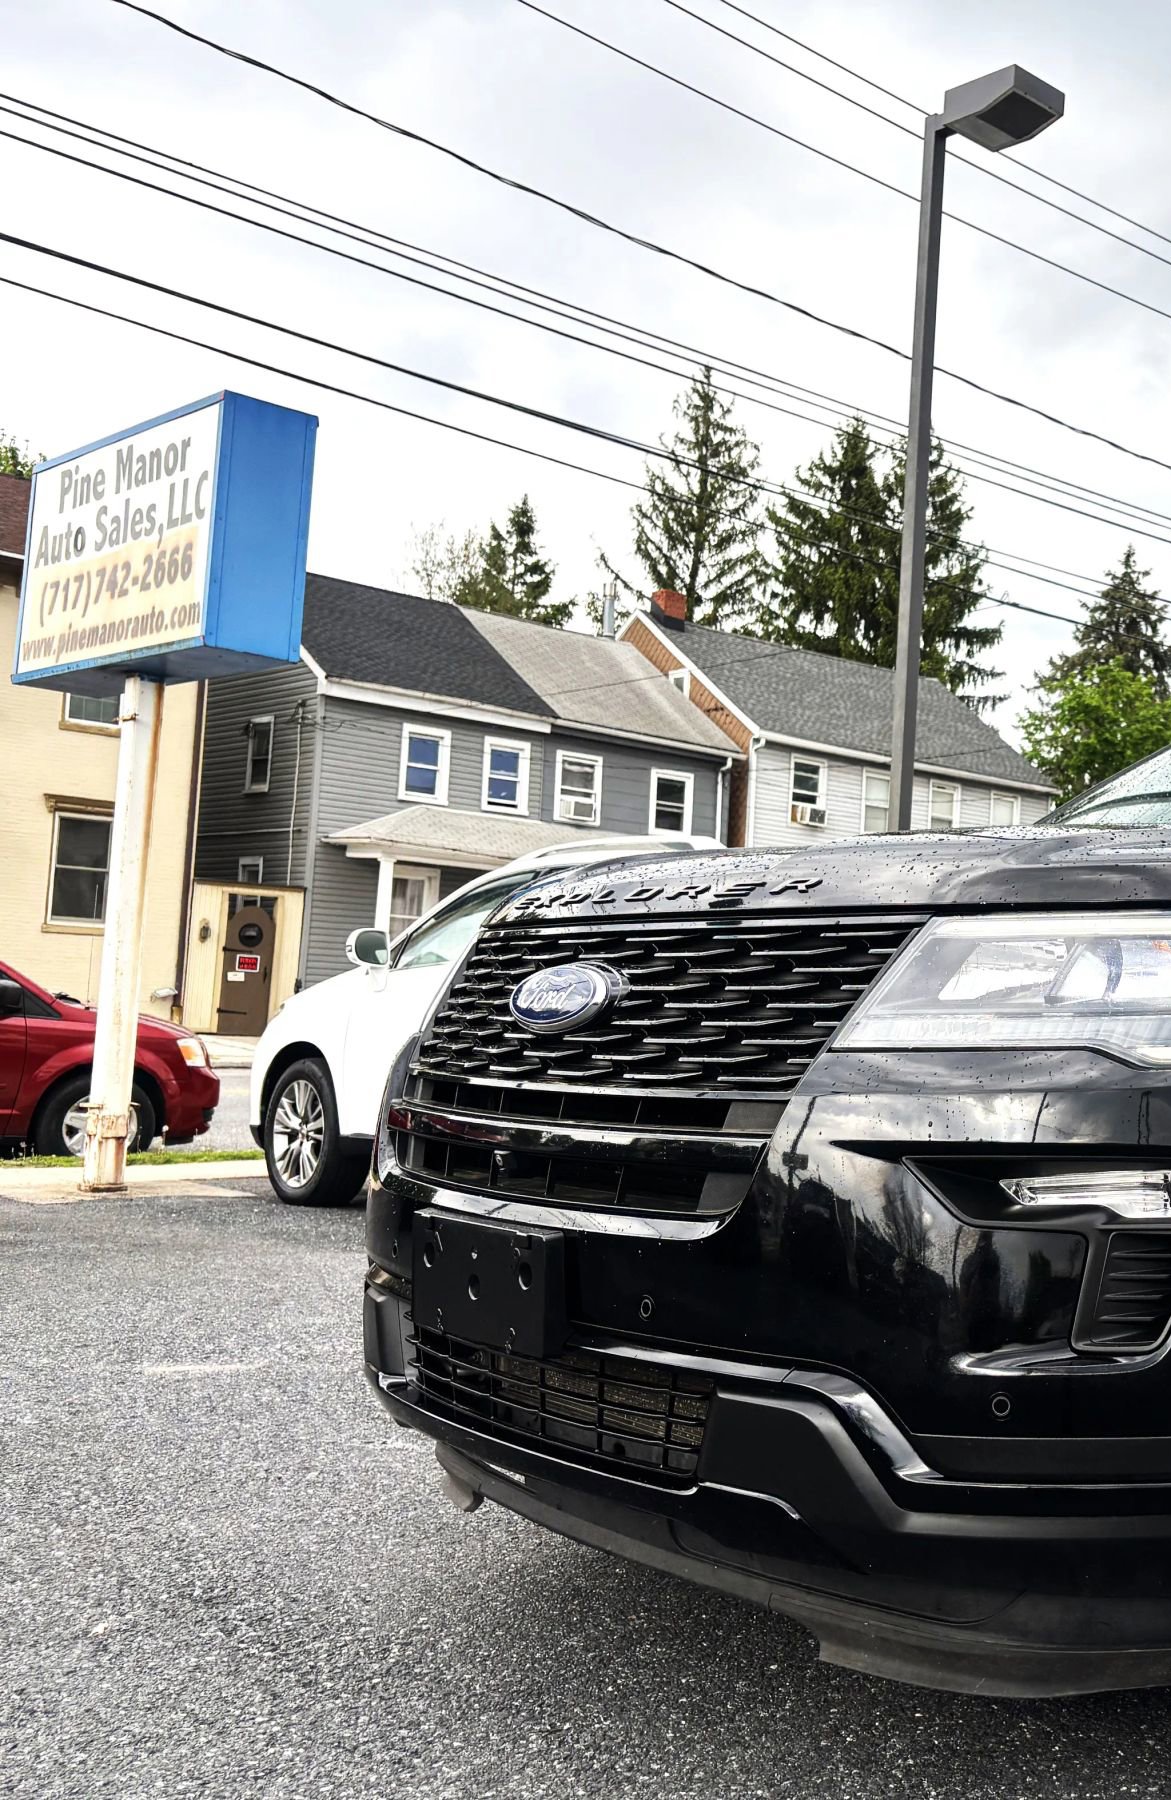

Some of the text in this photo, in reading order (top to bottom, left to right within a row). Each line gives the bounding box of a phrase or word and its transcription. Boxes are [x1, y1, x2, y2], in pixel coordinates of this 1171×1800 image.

[58, 436, 192, 514] Pine Manor
[34, 525, 86, 569] Auto
[39, 542, 193, 627] (717)742-2666
[22, 600, 200, 662] www.pinemanorauto.com
[514, 877, 823, 911] EXPLORER
[517, 972, 578, 1011] Ford
